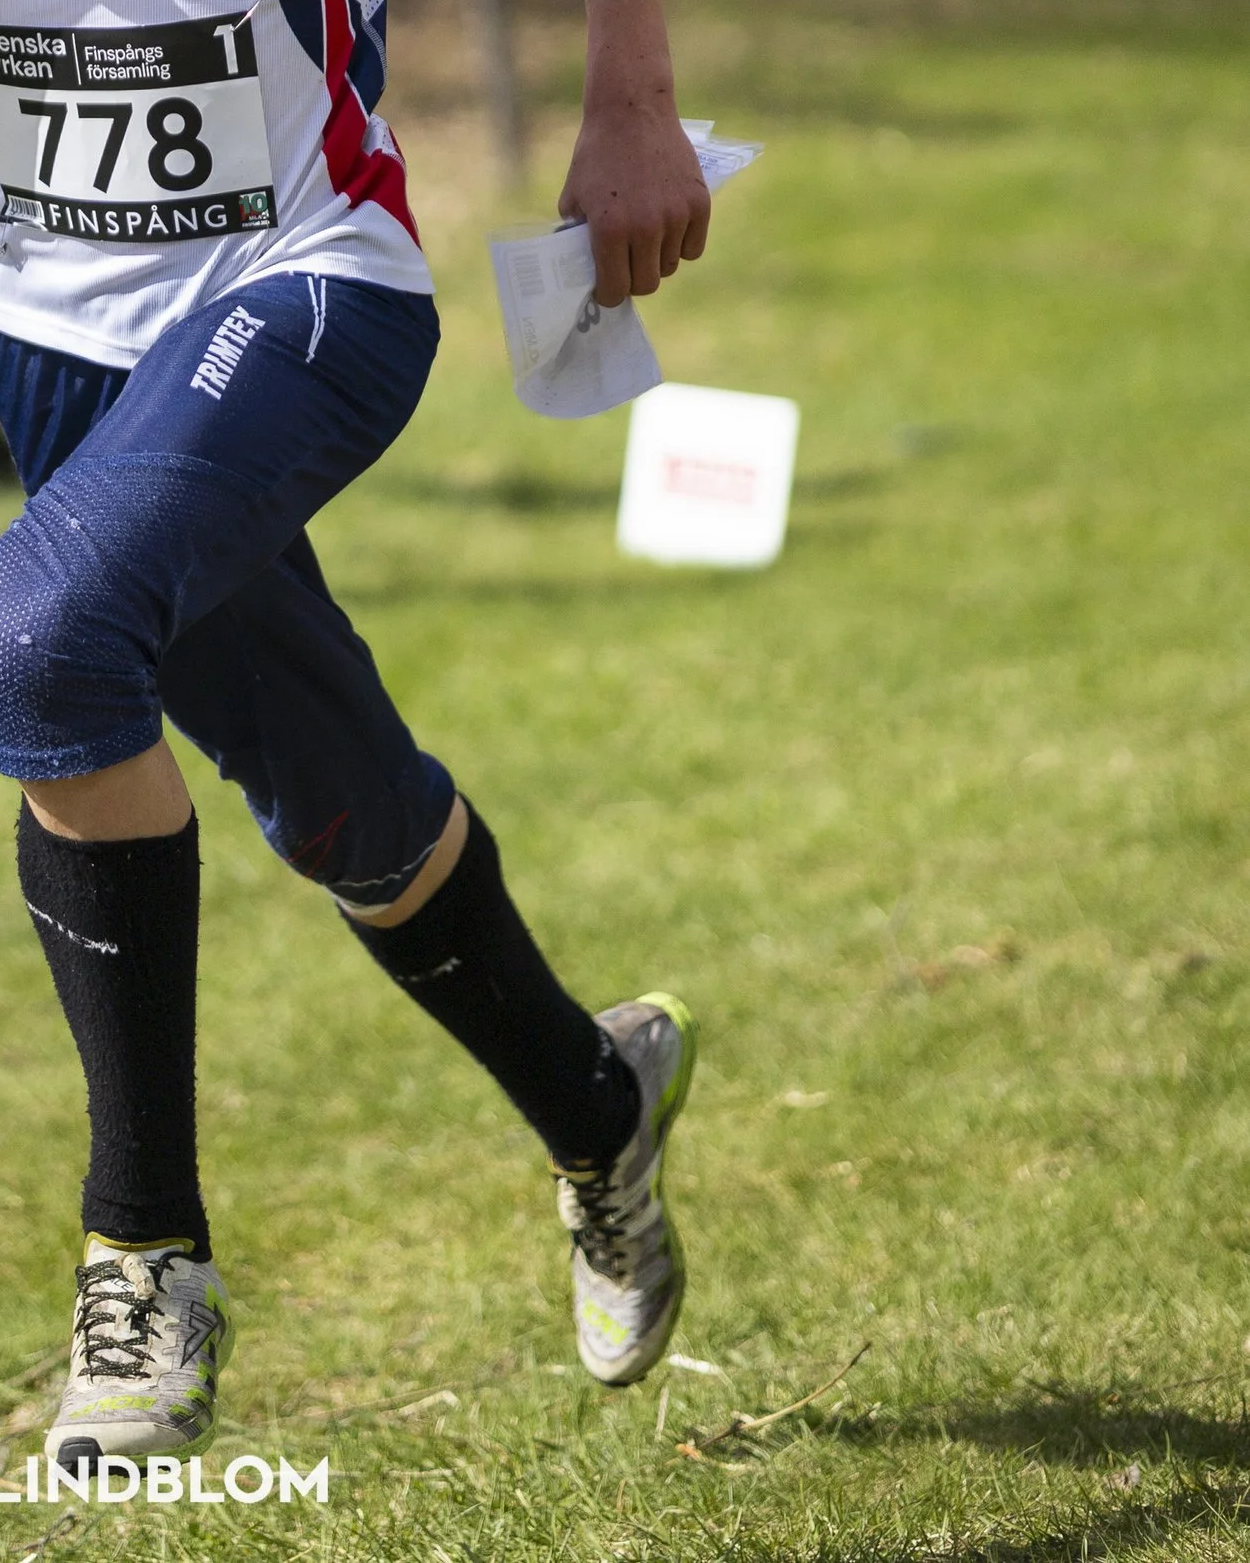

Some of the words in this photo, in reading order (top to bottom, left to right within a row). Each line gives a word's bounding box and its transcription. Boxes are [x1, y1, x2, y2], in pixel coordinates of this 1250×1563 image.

[84, 44, 164, 66] Finspångs
[213, 23, 240, 75] 1
[86, 61, 171, 81] församling
[17, 96, 214, 194] 778
[49, 204, 228, 236] FINSPÅNG
[190, 305, 267, 401] TRIMTEX
